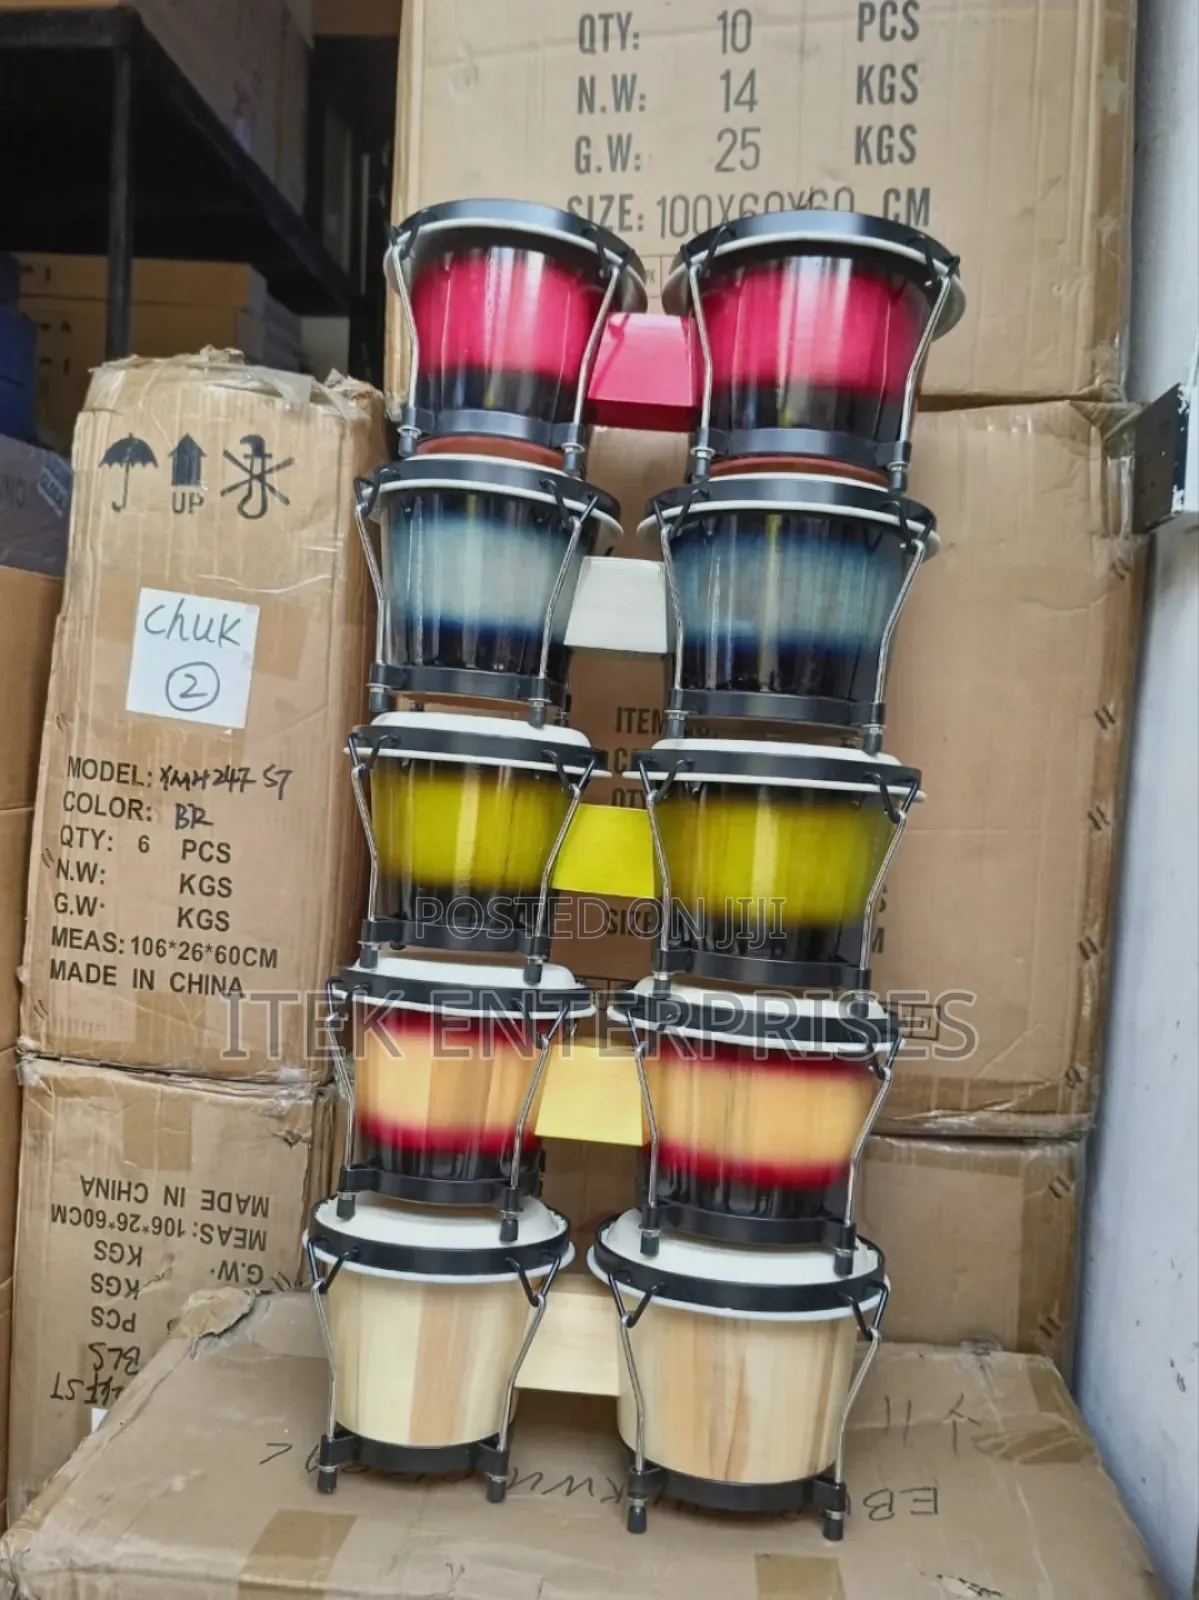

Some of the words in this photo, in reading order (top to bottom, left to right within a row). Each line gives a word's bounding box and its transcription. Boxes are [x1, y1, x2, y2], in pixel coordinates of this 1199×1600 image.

[577, 12, 641, 54] QTY:
[716, 10, 752, 54] 10
[857, 1, 920, 43] PCS
[576, 75, 647, 115] N.W:
[719, 69, 759, 114] 14
[856, 63, 919, 106] KGS
[573, 133, 643, 175] G.W:
[715, 127, 762, 173] 25
[853, 123, 917, 166] KGS
[882, 187, 931, 226] CM
[172, 492, 205, 514] UP
[67, 756, 153, 788] MODEL:
[63, 790, 152, 822] COLOR:
[60, 825, 113, 852] QTY:
[138, 835, 150, 854] 6
[181, 838, 231, 864] PCS
[56, 858, 106, 885] N.W:
[179, 873, 233, 899] KGS
[177, 907, 230, 932] KGS
[51, 925, 124, 954] MEAS:
[49, 958, 117, 986] MADE
[132, 968, 154, 991] IN
[169, 971, 245, 999] CHINA
[80, 1175, 148, 1203] CHINA
[163, 1185, 186, 1207] IN
[200, 1189, 270, 1218] MADE
[192, 1221, 267, 1251] MEAS:
[94, 1239, 143, 1267] KGS
[90, 1273, 140, 1299] KGS
[91, 1306, 136, 1333] PCS
